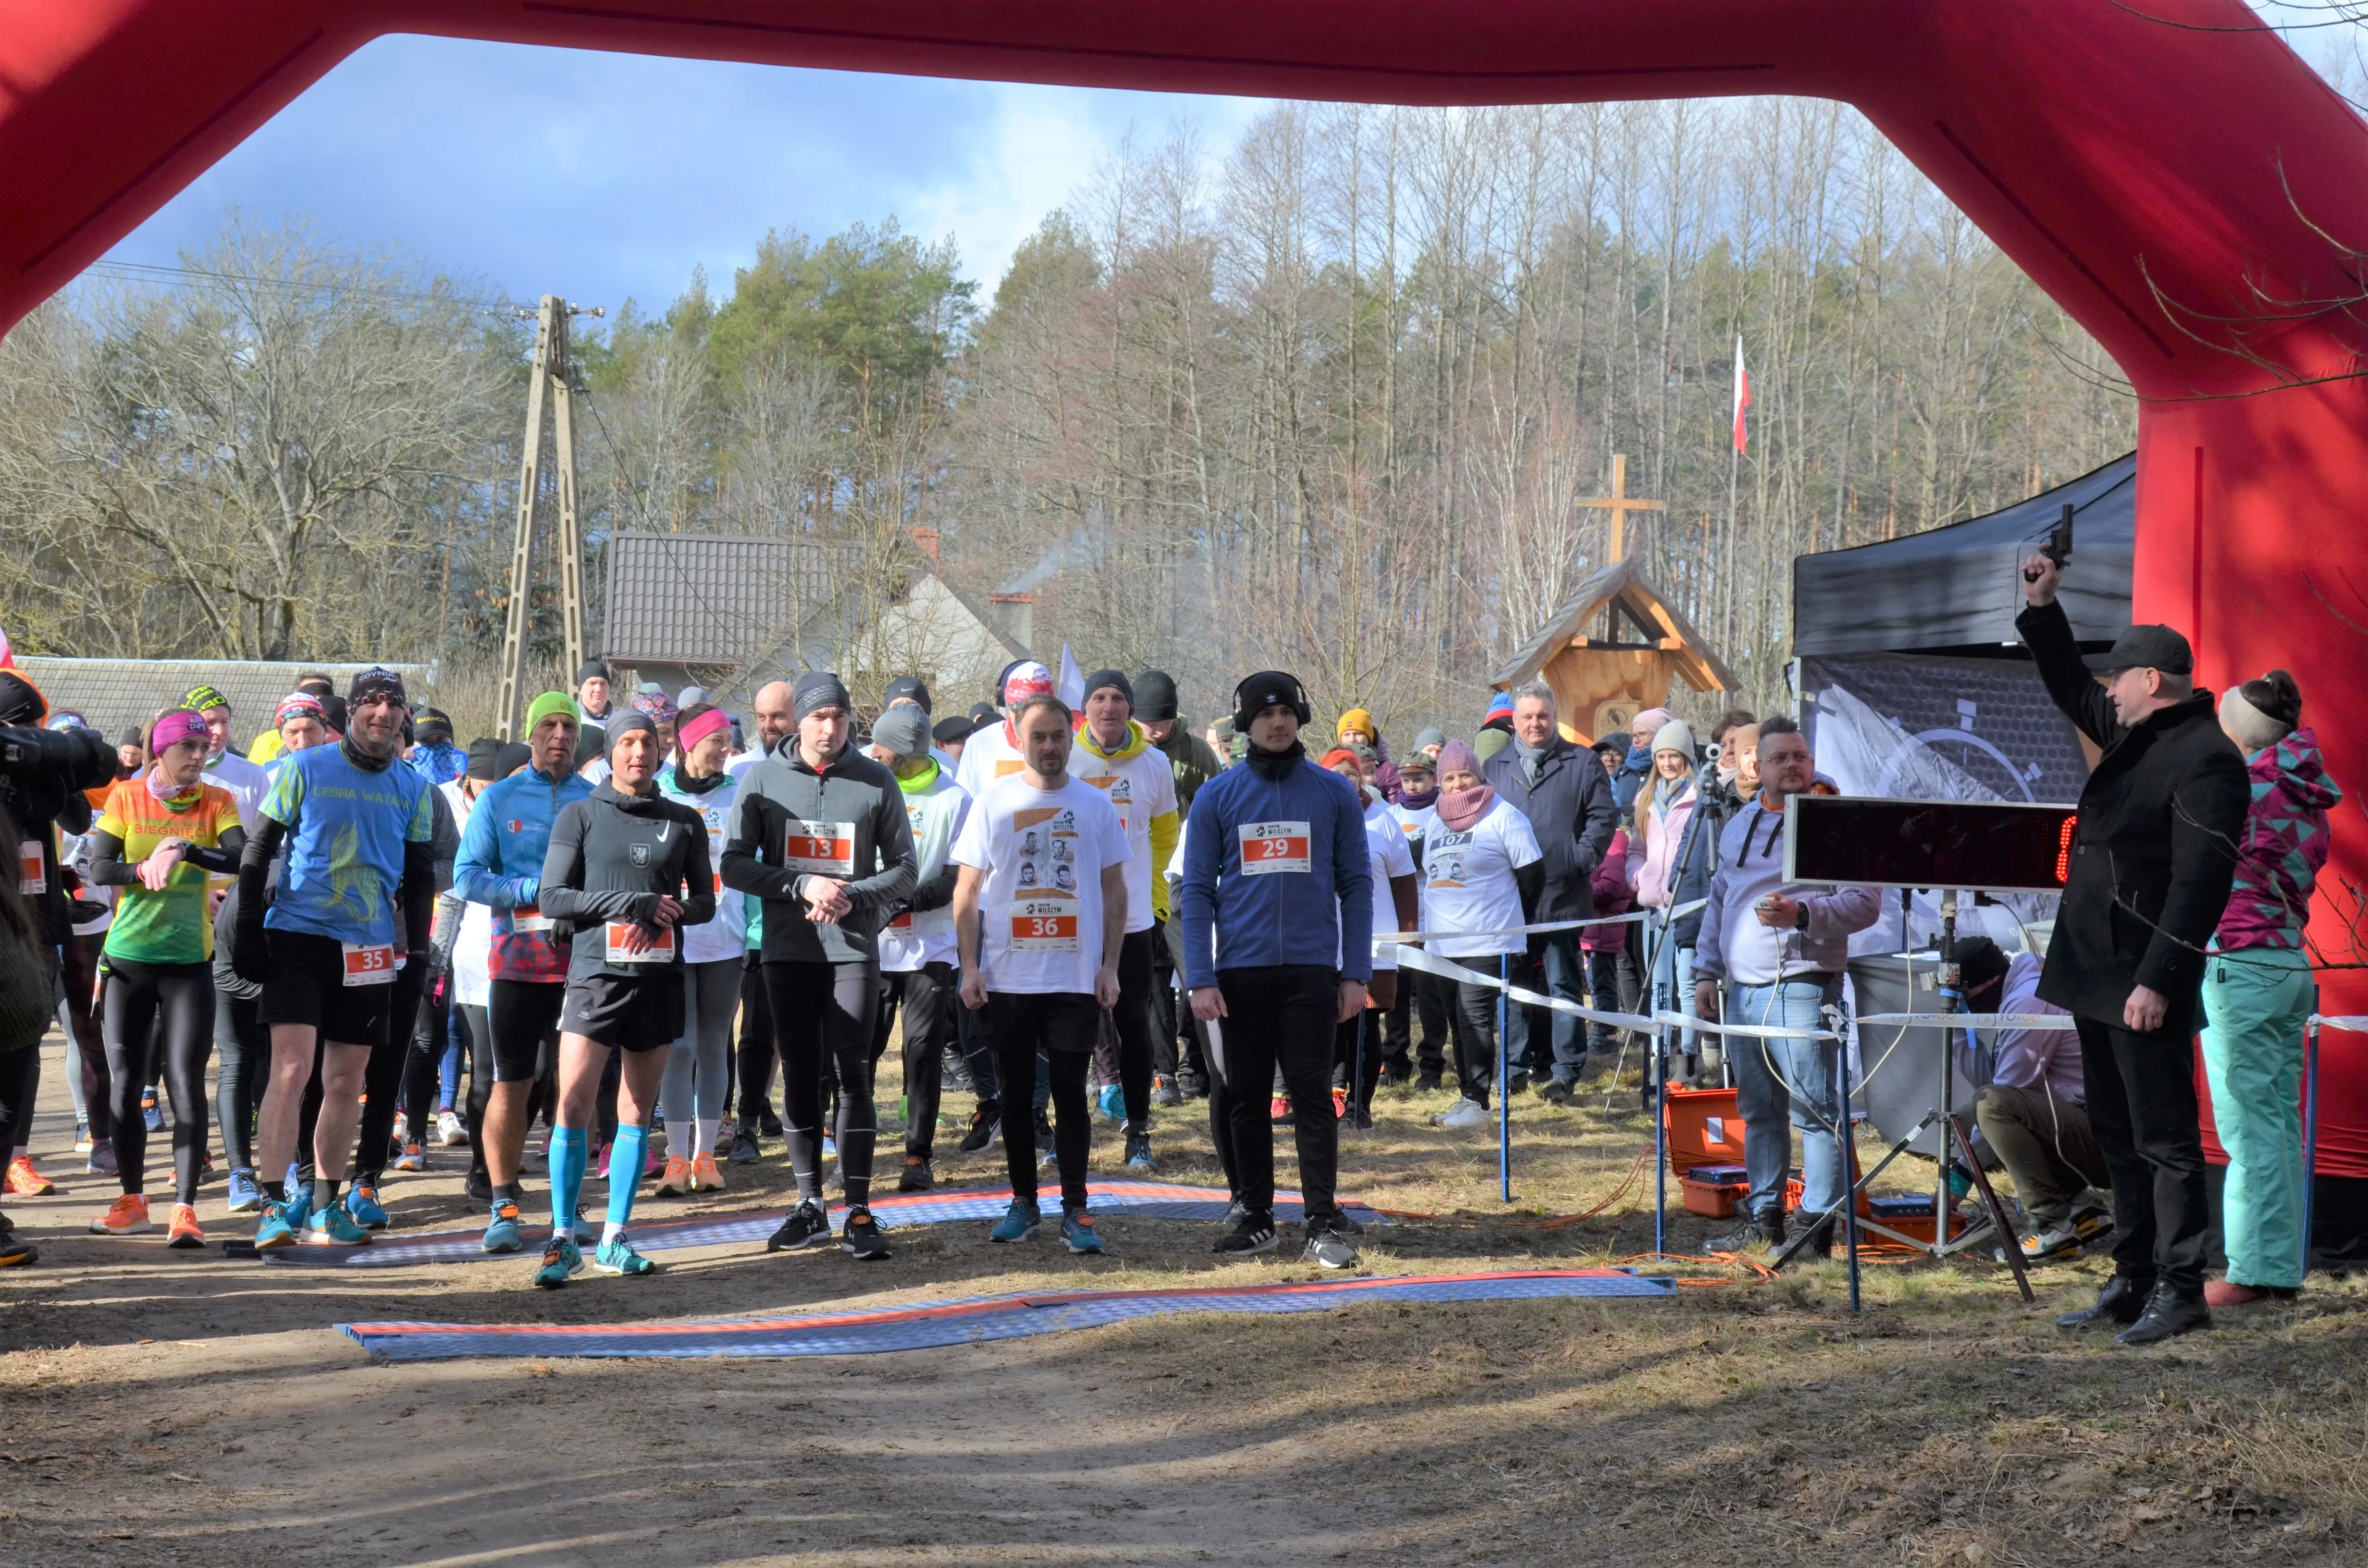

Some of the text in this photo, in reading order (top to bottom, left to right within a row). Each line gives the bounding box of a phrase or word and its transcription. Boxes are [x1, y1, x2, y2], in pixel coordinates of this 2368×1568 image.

[358, 671, 395, 682] GDYNIA
[808, 839, 831, 857] 13
[1262, 839, 1289, 858] 29
[1439, 833, 1466, 847] 107
[1032, 918, 1058, 936] 36
[362, 951, 383, 969] 35
